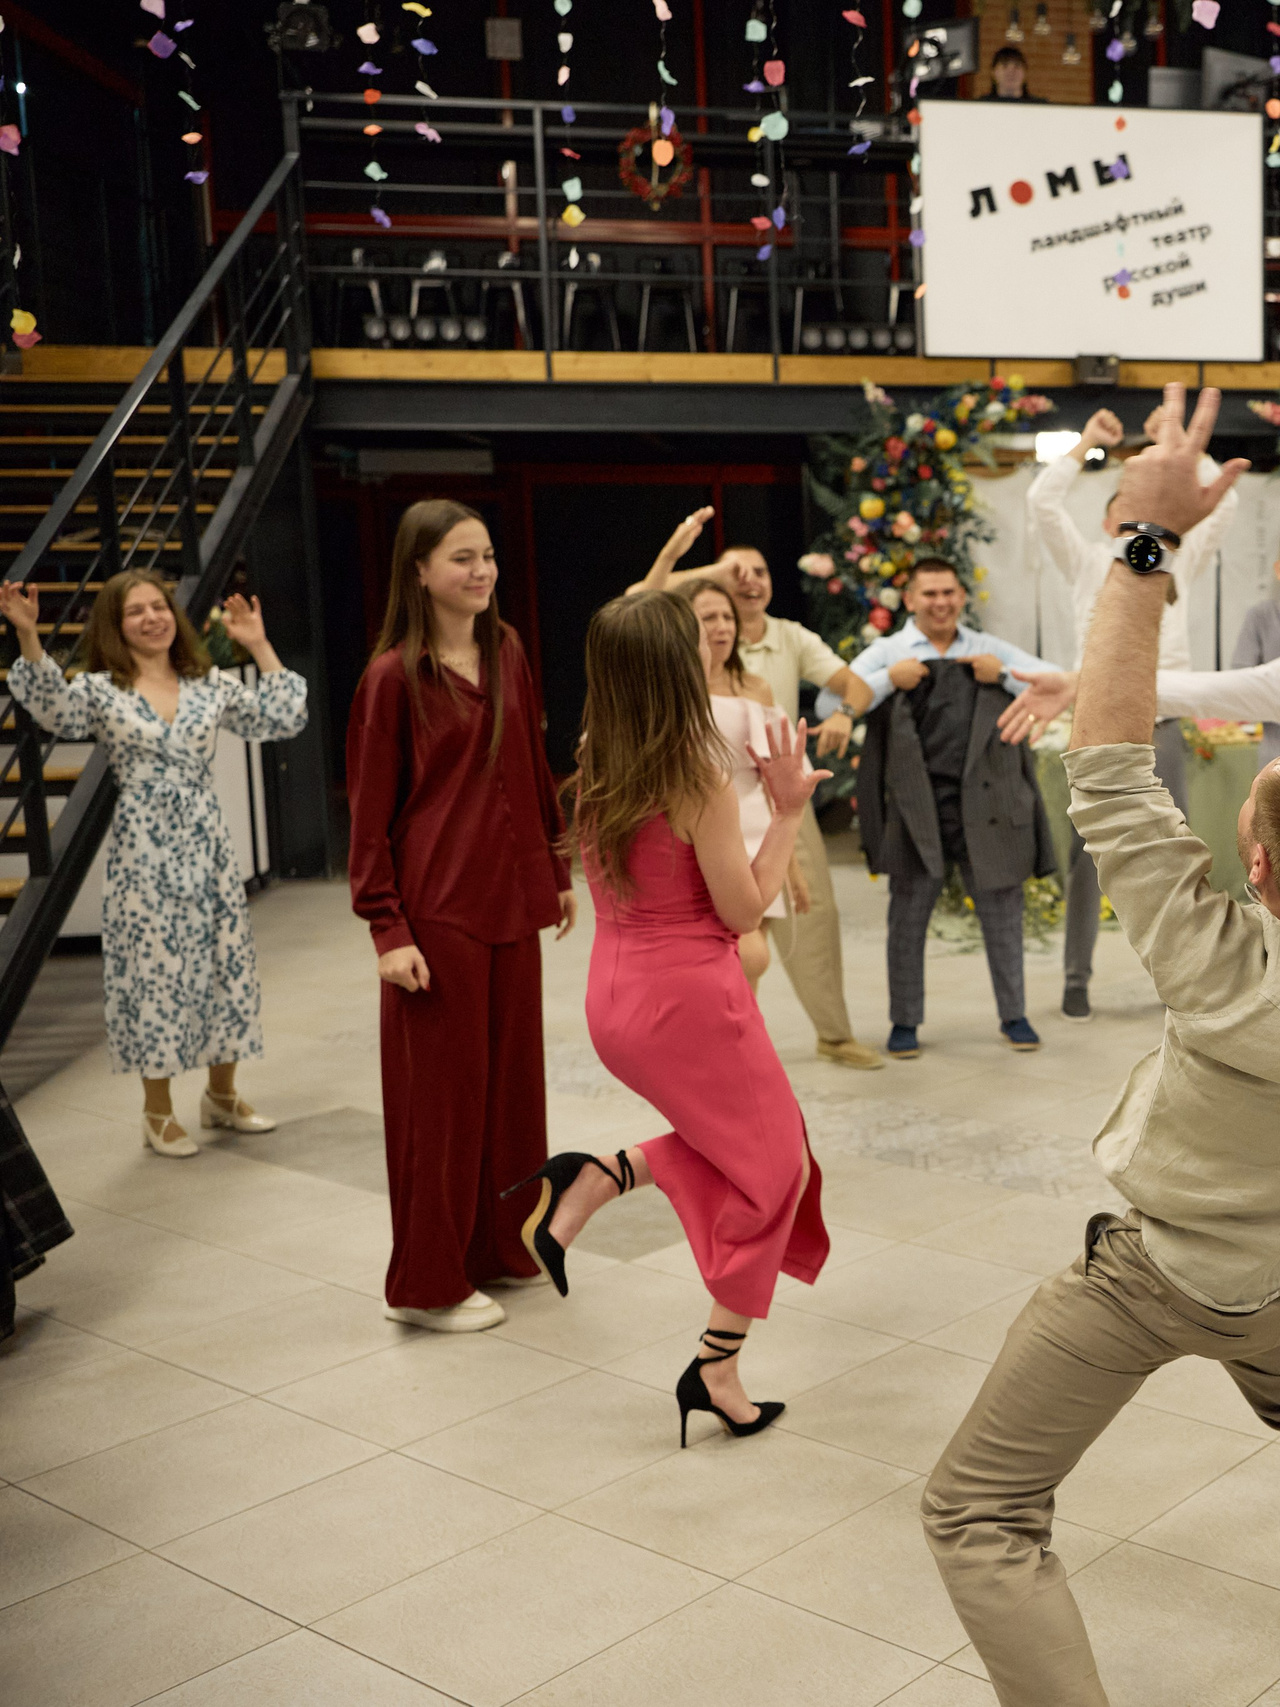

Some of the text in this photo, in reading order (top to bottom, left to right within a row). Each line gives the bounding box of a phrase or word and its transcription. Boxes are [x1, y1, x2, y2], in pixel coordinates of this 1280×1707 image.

[1031, 197, 1185, 253] ландшафтный
[1151, 224, 1212, 249] театр
[1103, 252, 1191, 295] рсской
[1151, 280, 1206, 307] души
